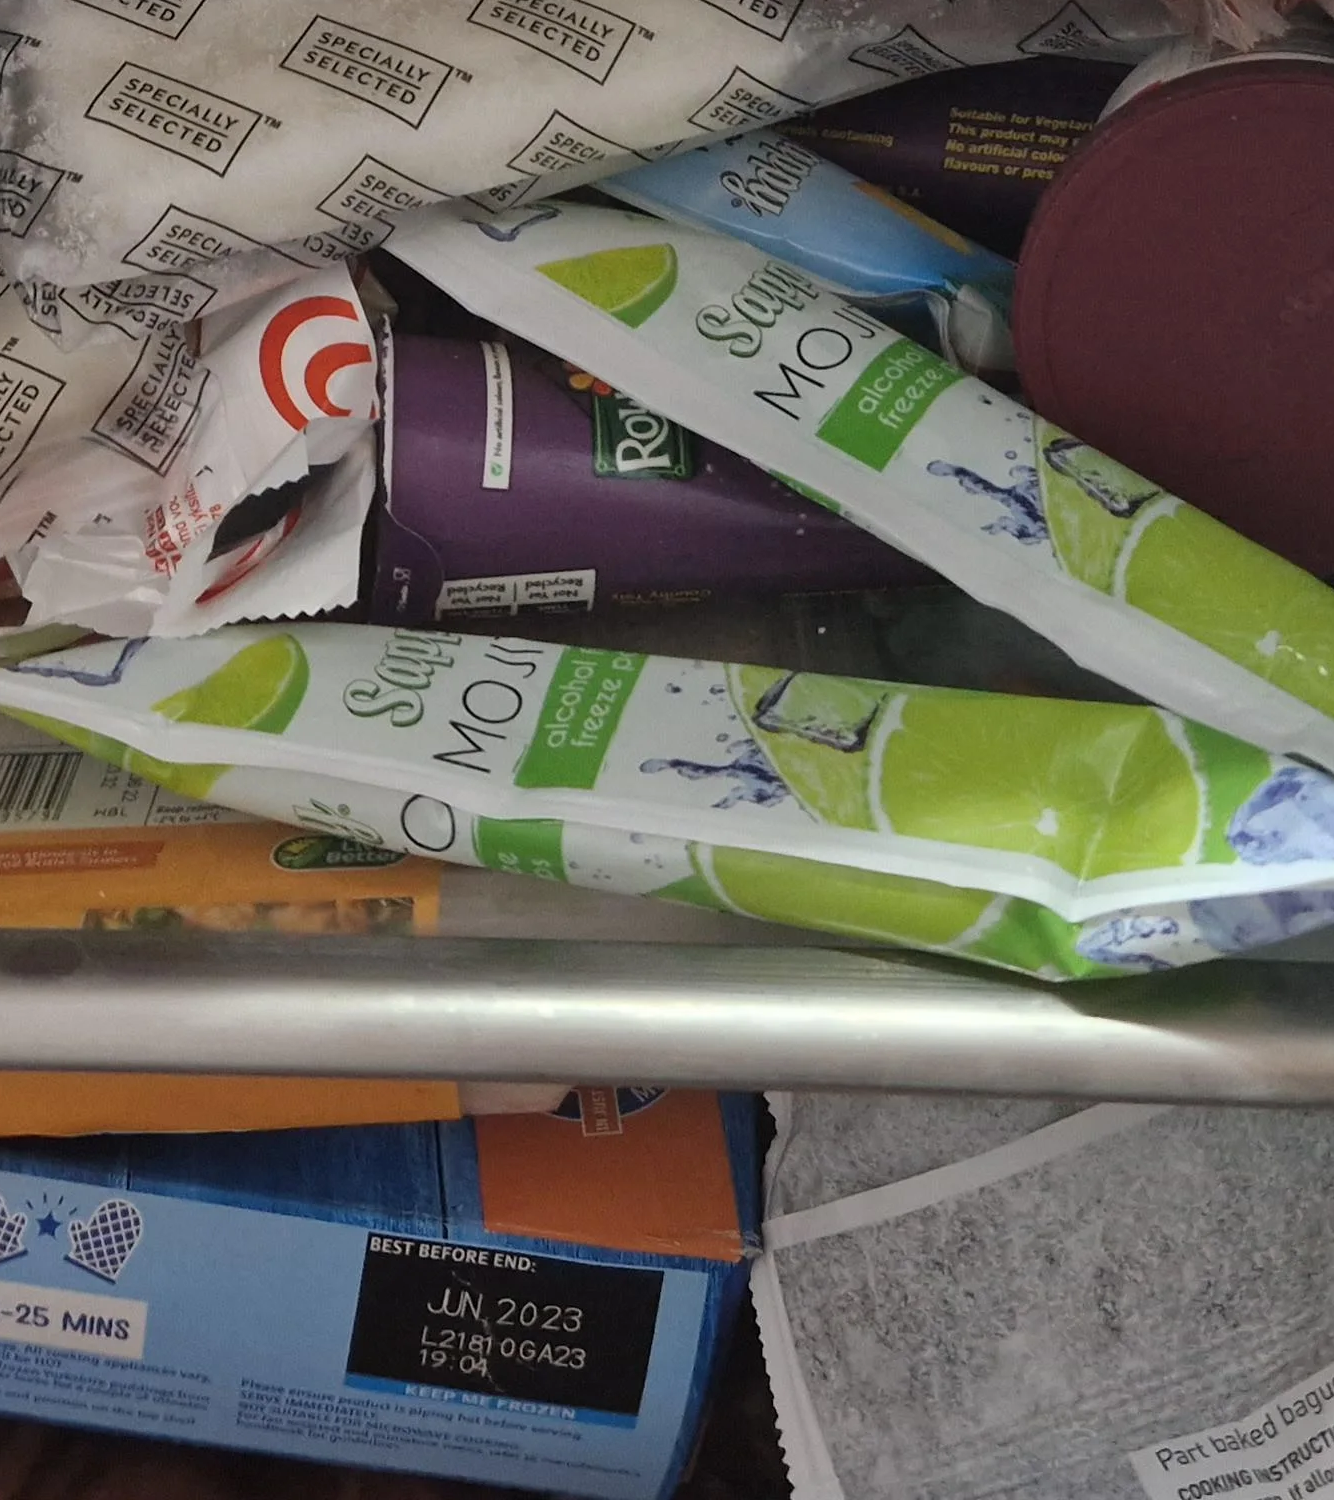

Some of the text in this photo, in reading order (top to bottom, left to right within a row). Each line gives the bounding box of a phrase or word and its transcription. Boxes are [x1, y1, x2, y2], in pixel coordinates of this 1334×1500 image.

[490, 5, 603, 63] SELECTED
[316, 31, 431, 83] SPECIALLY
[303, 49, 418, 107] SELECTED
[124, 77, 240, 132] SPECIALLY
[1011, 112, 1032, 127] for
[108, 98, 223, 154] SELECTED
[948, 121, 1069, 149] This product may
[943, 156, 1000, 175] flavours
[1004, 164, 1019, 177] or
[944, 138, 1028, 160] No artificial
[115, 328, 181, 433] SPECIALLY
[447, 582, 507, 598] Recycled
[524, 575, 585, 592] Recycled
[546, 658, 598, 750] alcohol
[570, 677, 624, 749] freeze
[369, 1235, 538, 1274] BEST BEFORE END:
[61, 1309, 132, 1342] MINS
[495, 1297, 585, 1334] 2023
[419, 1347, 489, 1379] 19:04
[404, 1384, 578, 1421] KEEP ME FROZEN
[1154, 1441, 1210, 1472] Part
[1207, 1413, 1280, 1454] baked
[1177, 1467, 1253, 1500] COOKING
